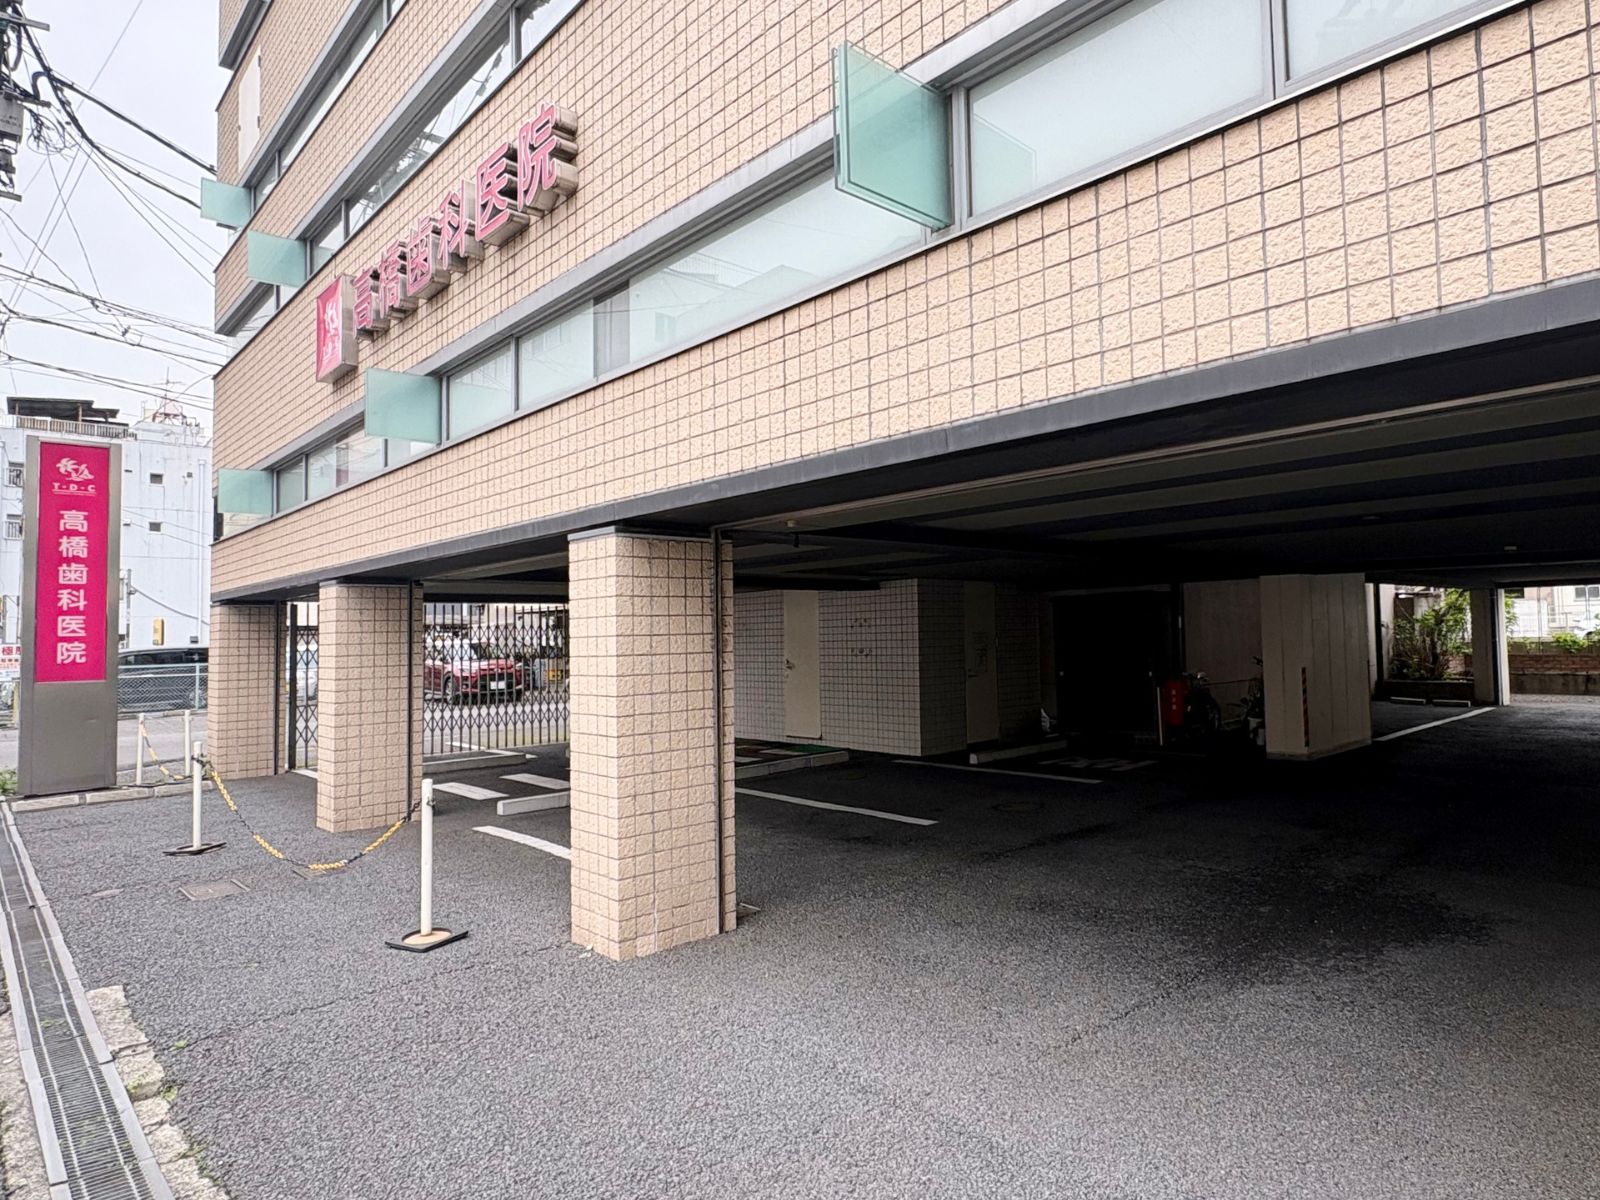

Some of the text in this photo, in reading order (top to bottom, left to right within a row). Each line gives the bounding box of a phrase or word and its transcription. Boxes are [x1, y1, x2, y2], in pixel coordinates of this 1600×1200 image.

[353, 102, 560, 341] 高橋歯科医院
[56, 509, 89, 664] 高橋歯科医院
